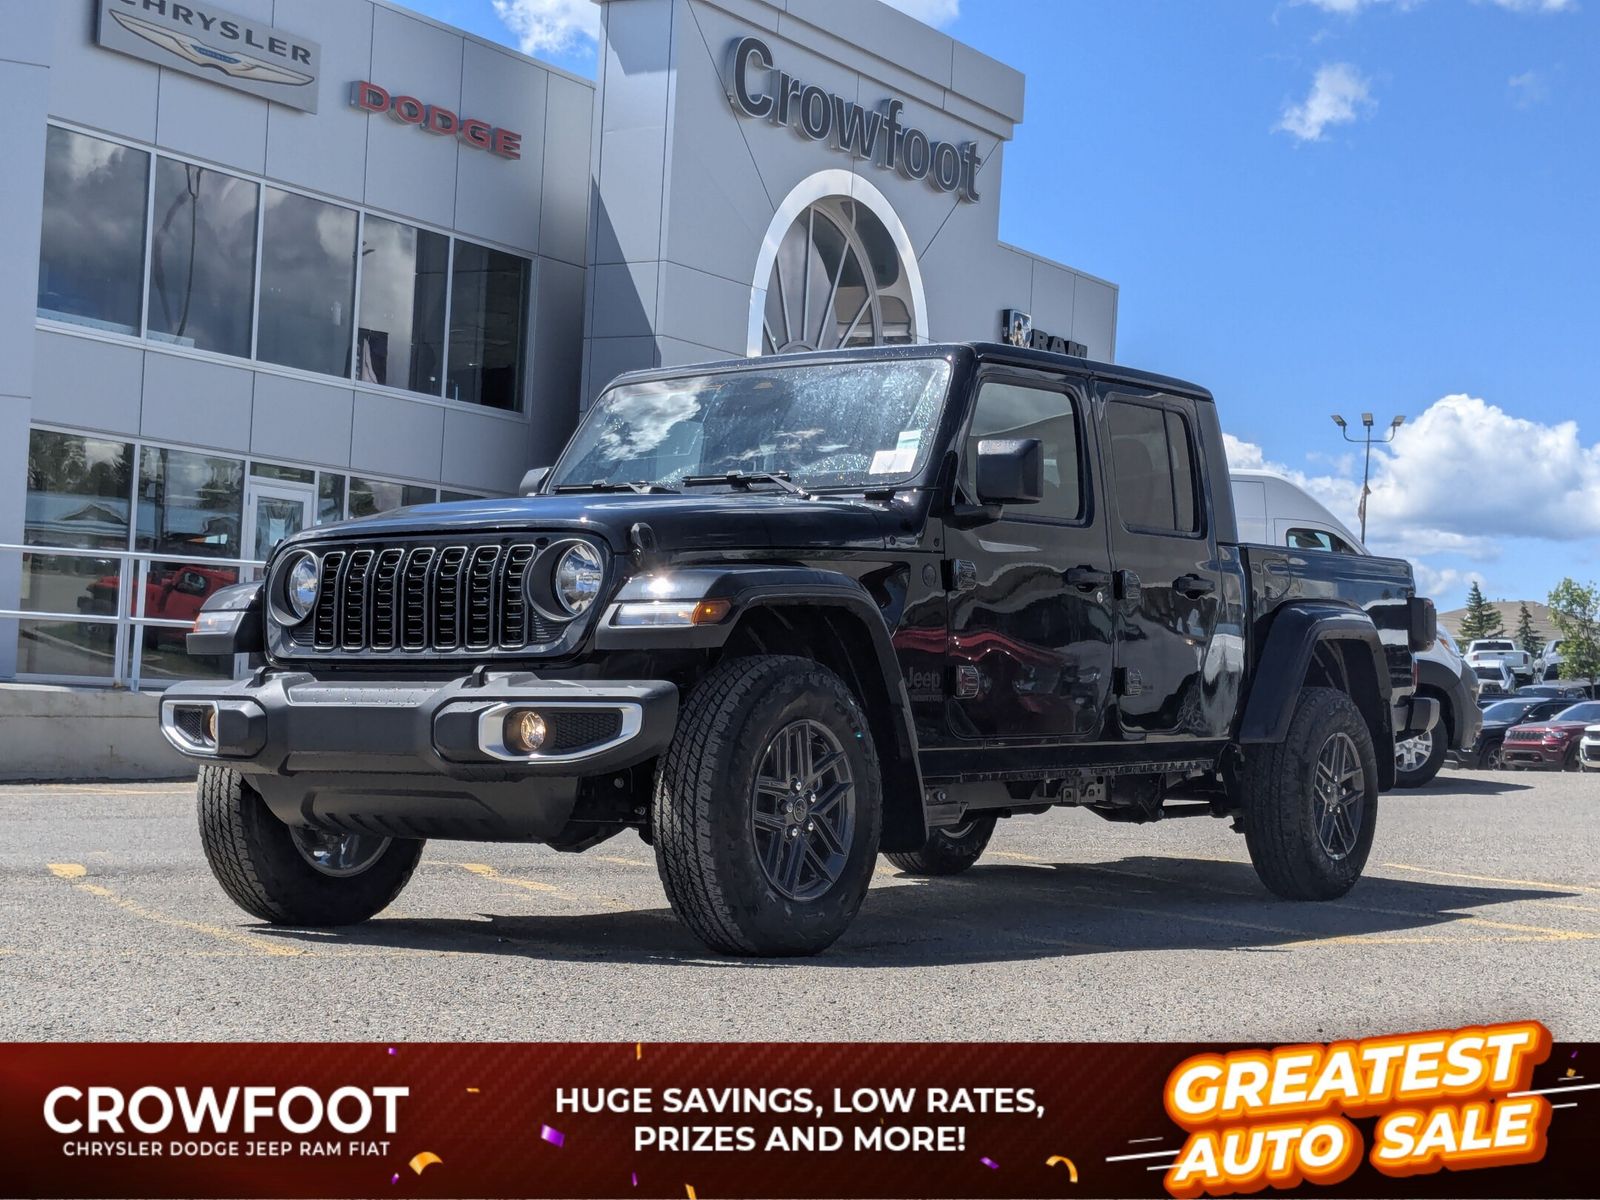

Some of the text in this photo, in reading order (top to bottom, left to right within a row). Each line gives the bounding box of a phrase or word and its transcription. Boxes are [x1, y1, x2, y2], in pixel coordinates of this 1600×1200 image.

[119, 0, 312, 66] HRYSLER
[353, 80, 522, 161] DODGE
[729, 35, 982, 203] Crowfoot
[1031, 328, 1088, 359] RAM
[904, 666, 941, 692] Jeep
